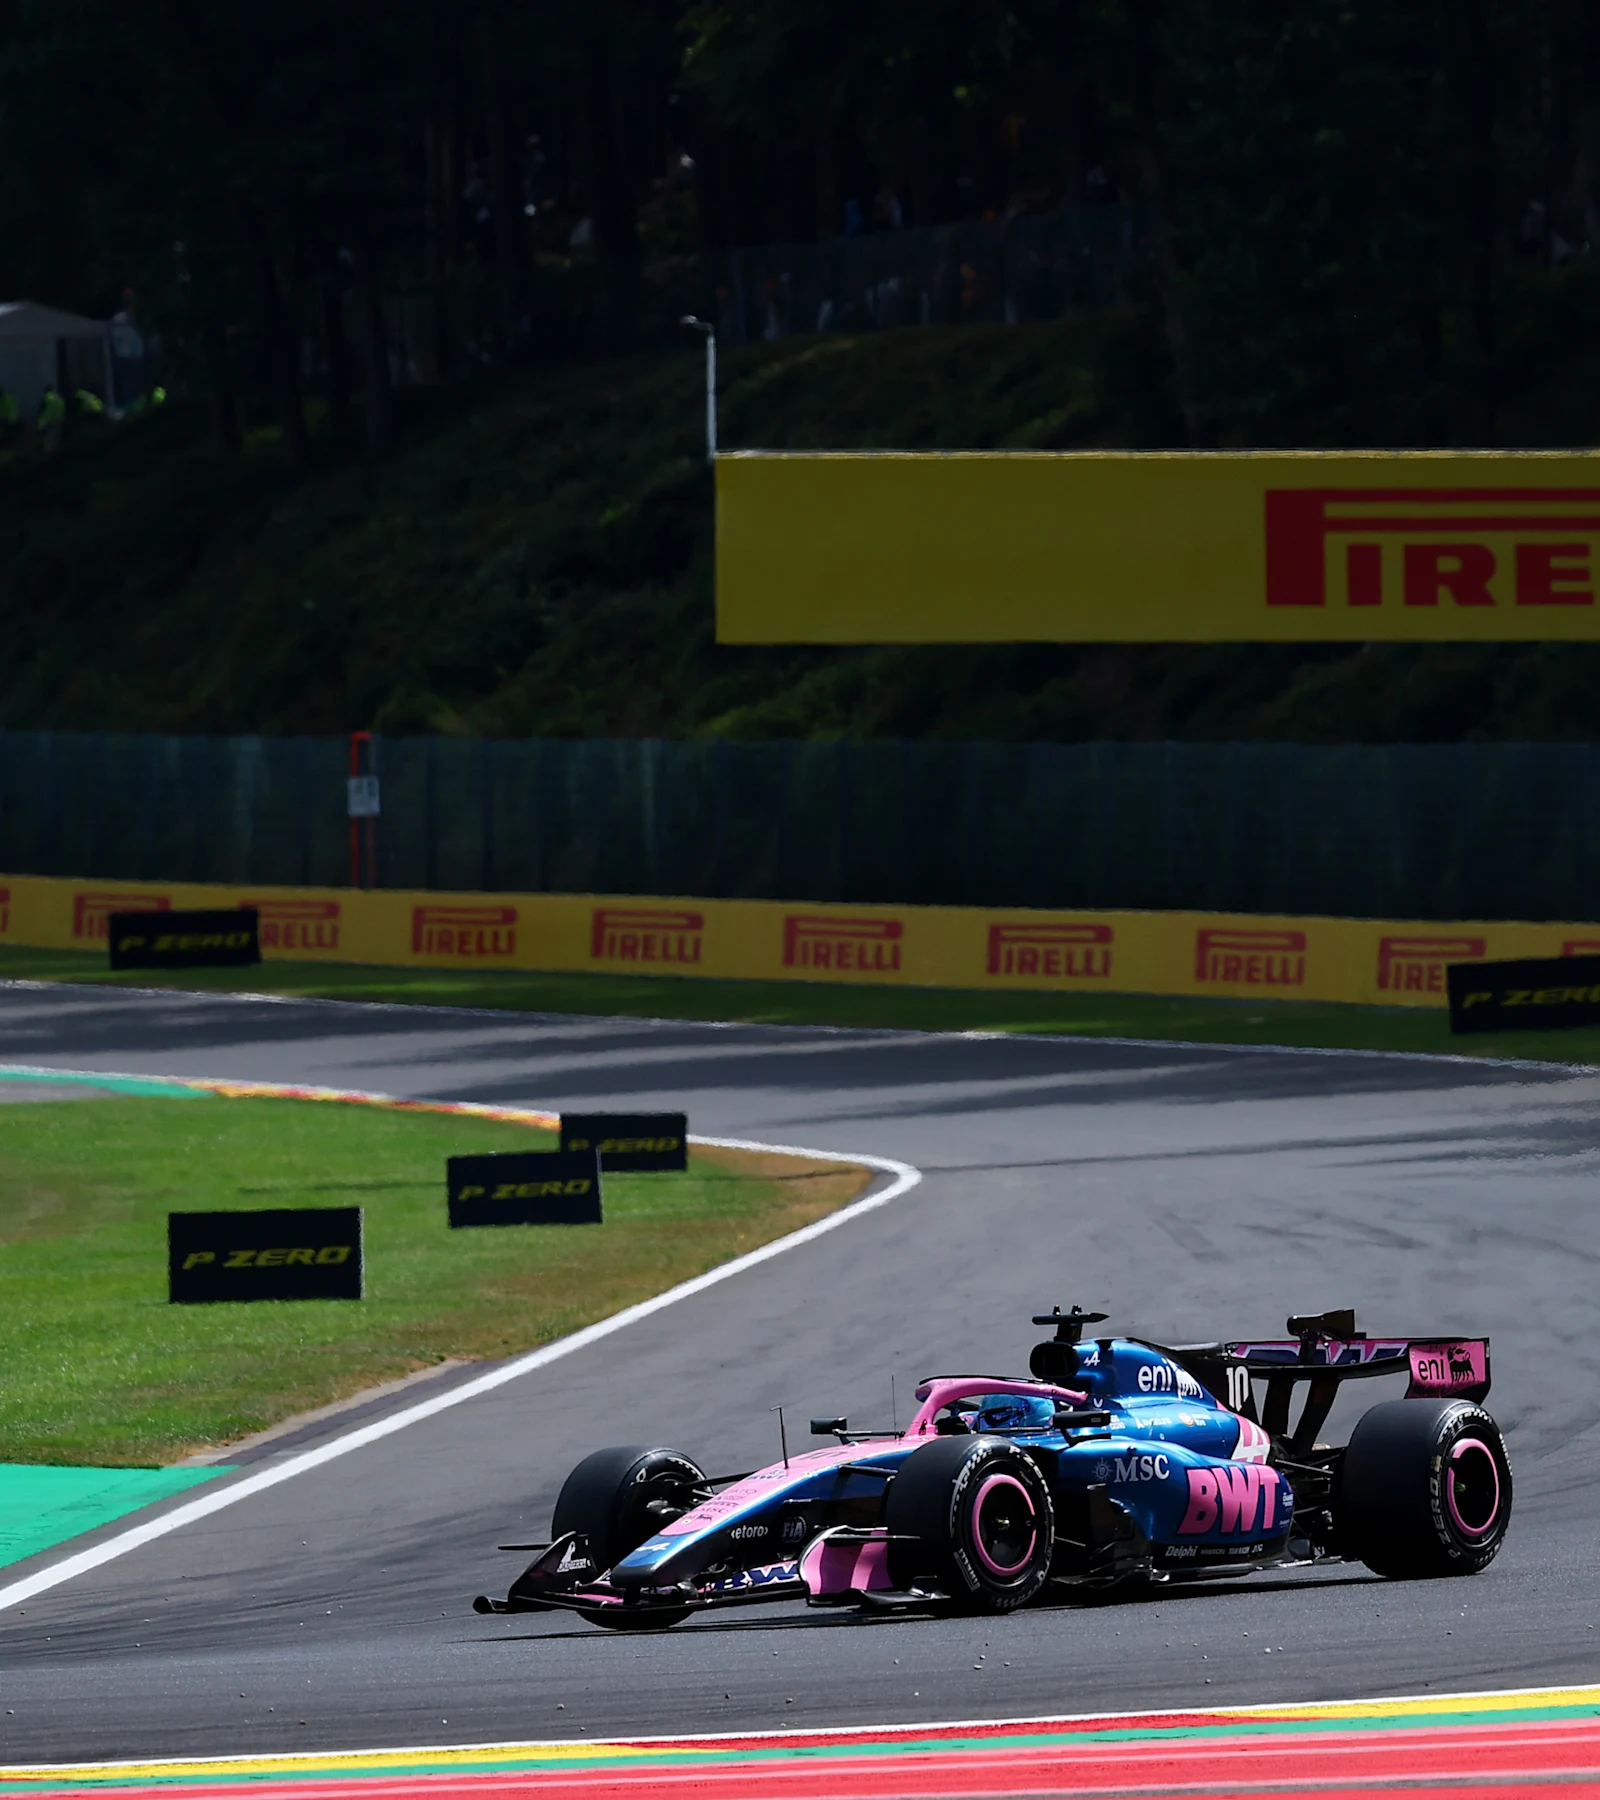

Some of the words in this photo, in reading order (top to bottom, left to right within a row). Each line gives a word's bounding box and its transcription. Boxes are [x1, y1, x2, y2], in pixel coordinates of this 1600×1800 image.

[412, 906, 518, 955] PIRELLI
[591, 909, 704, 963] PIRELLI
[783, 916, 904, 971] PIRELLI
[987, 924, 1113, 977] PIRELLI
[1195, 929, 1307, 985] PIRELLI
[1461, 991, 1493, 1009] P
[458, 1185, 485, 1202] P
[491, 1178, 592, 1200] ZERO
[181, 1251, 216, 1271] P
[221, 1245, 352, 1269] ZERO
[1138, 1358, 1173, 1392] eni
[1419, 1352, 1445, 1381] eni
[1226, 1365, 1249, 1412] 10
[1113, 1454, 1170, 1483] MSC
[1177, 1464, 1281, 1535] BWT
[1429, 1477, 1451, 1544] ZERO
[782, 1521, 801, 1540] FIA
[1165, 1545, 1198, 1559] Delphi
